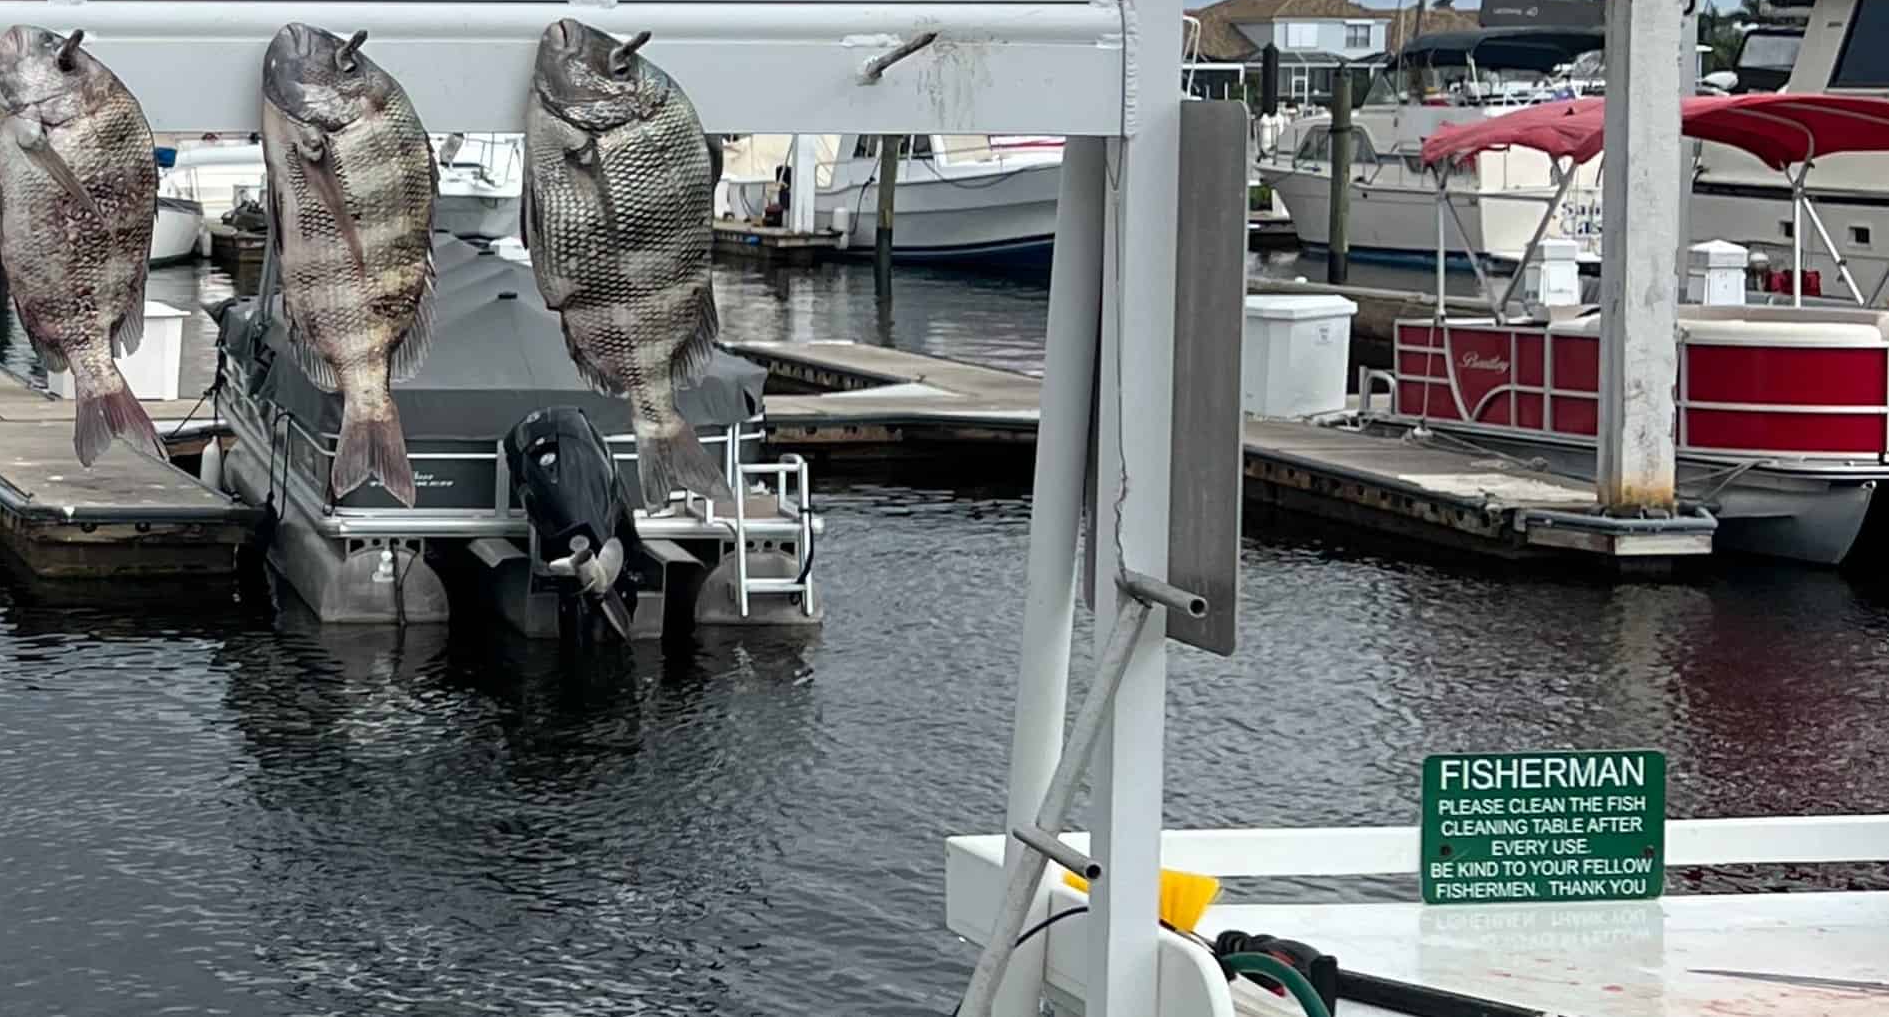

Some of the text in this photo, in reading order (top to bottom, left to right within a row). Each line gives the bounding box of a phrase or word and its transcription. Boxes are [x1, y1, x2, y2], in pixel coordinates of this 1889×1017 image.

[1440, 756, 1644, 790] FISHERMAN
[1438, 796, 1646, 815] PLEASE CLEAN THE FISH
[1441, 816, 1643, 836] CLEANING TABLE AFTER
[1492, 839, 1591, 855] EVERY USE.
[1430, 858, 1653, 878] BE KIND TO YOUR FELLOW
[1436, 879, 1646, 899] FISHERMEN. THANK YOU
